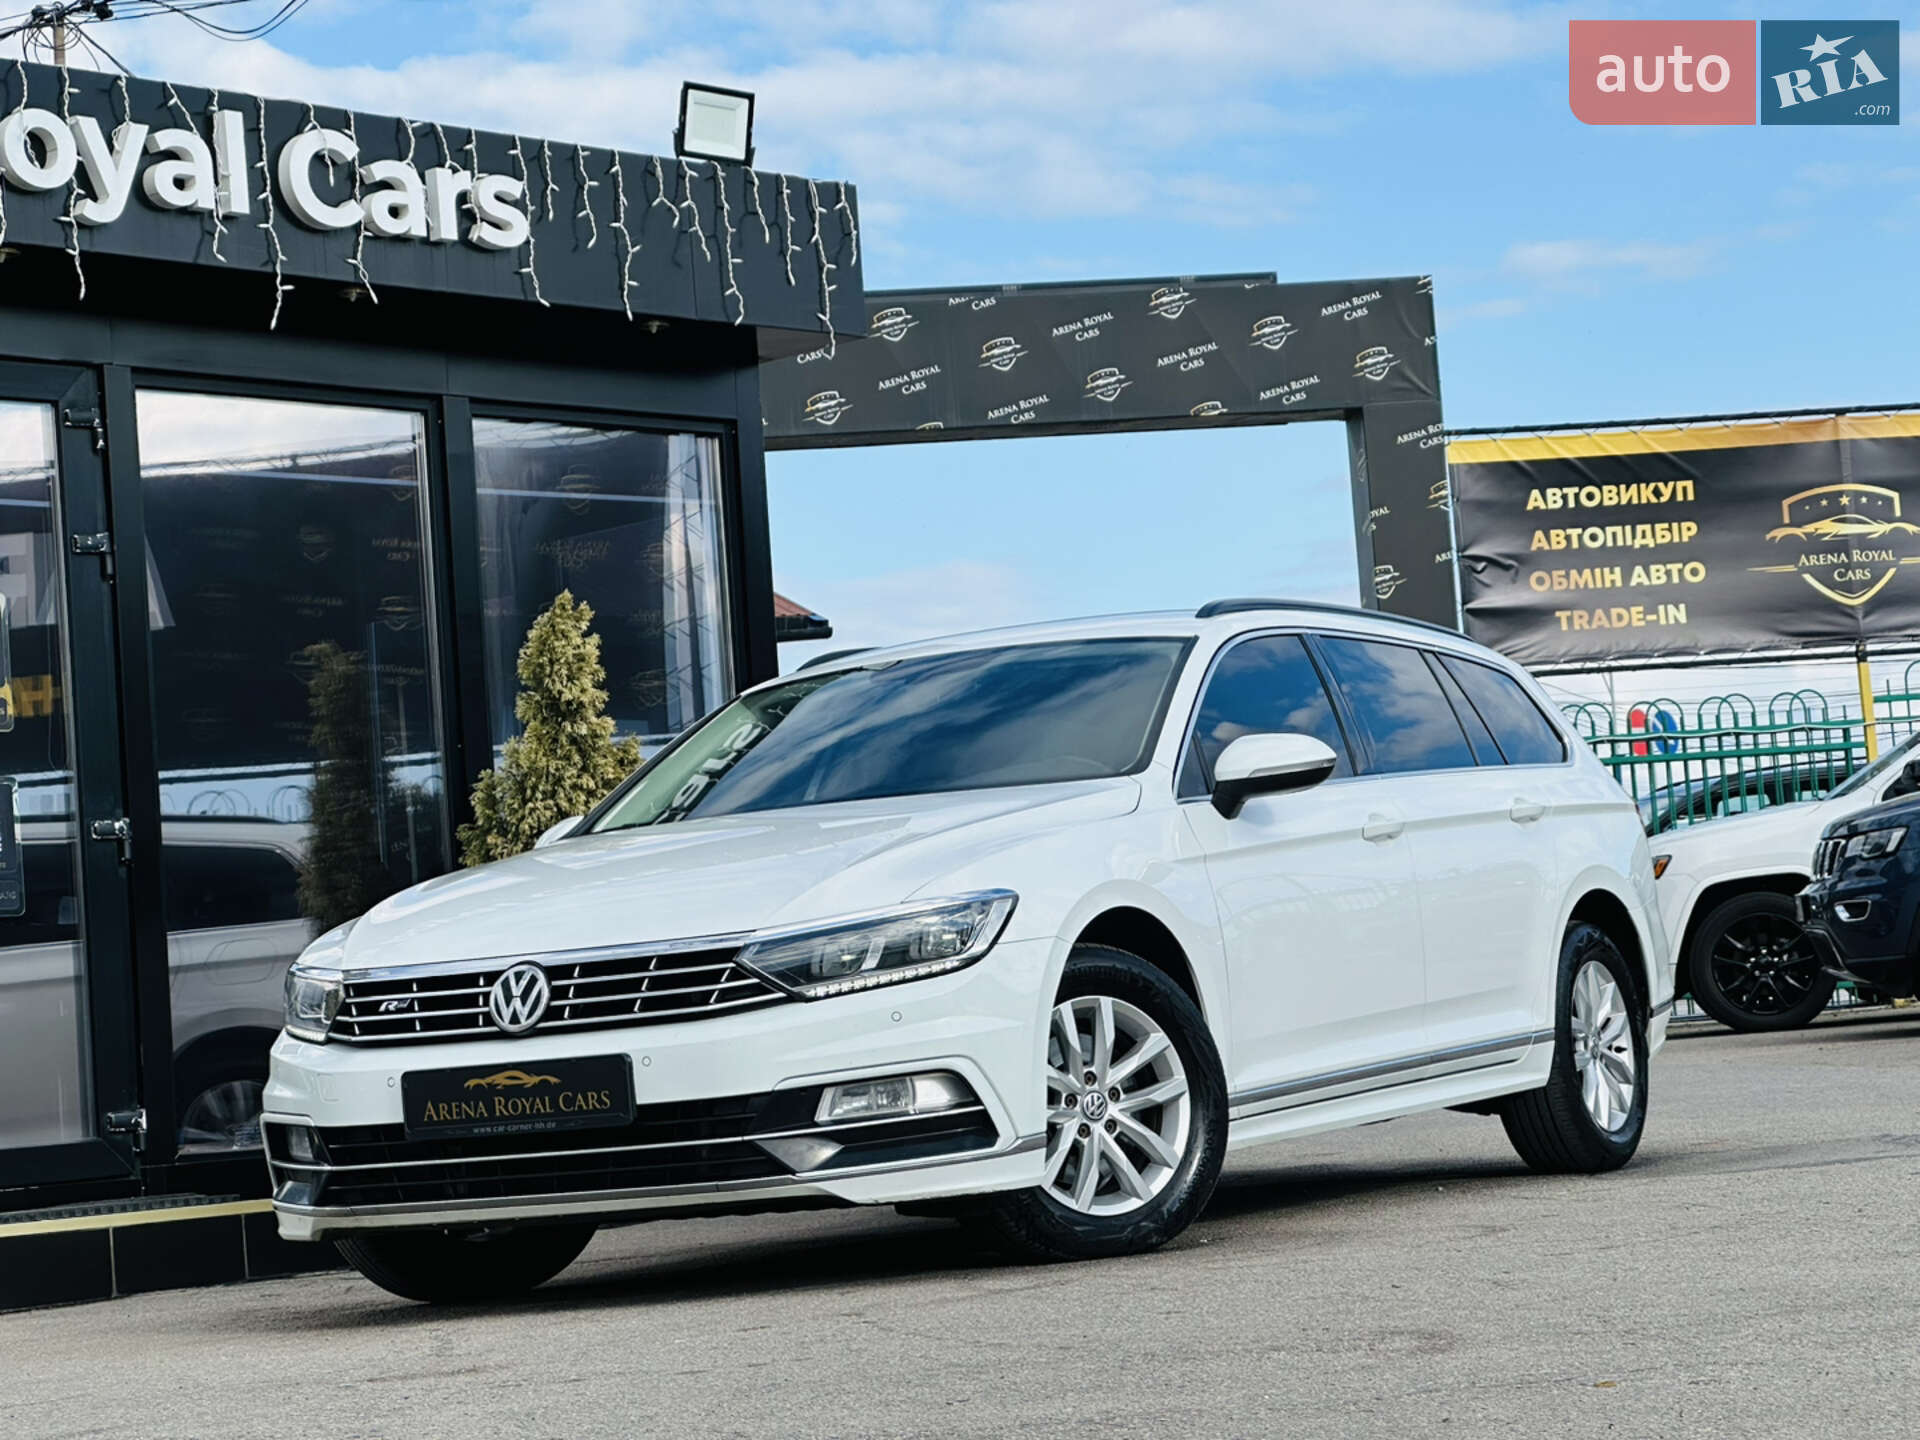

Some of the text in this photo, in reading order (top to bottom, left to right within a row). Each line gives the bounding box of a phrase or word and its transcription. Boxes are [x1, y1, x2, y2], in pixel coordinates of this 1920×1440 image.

[278, 128, 531, 251] Cars
[971, 296, 997, 311] CARS
[1320, 290, 1382, 317] ARENA ROYAL
[1343, 307, 1368, 321] CARS
[1052, 311, 1114, 337] ARENA ROYAL
[1075, 327, 1100, 342] CARS
[797, 349, 824, 364] CARS
[1157, 341, 1219, 367] ARENA ROYAL
[1180, 358, 1205, 372] CARS
[878, 364, 941, 391] ARENA ROYAL
[902, 381, 927, 395] CARS
[1259, 375, 1320, 400] ARENA ROYAL
[987, 394, 1051, 420] ARENA ROYAL
[1282, 391, 1307, 405] CARS
[1010, 411, 1036, 424] CARS
[1397, 429, 1427, 444] ARENA
[1526, 480, 1695, 511] АВТОВИКУП
[1530, 521, 1699, 552] АВТОПІДБІР
[1798, 548, 1896, 567] ARENA ROYAL
[1529, 562, 1706, 593] ОБМІН АВТО
[1834, 567, 1872, 583] CARS
[1556, 603, 1688, 632] TRADE-IN
[423, 1090, 611, 1122] ARENA ROYAL CARS
